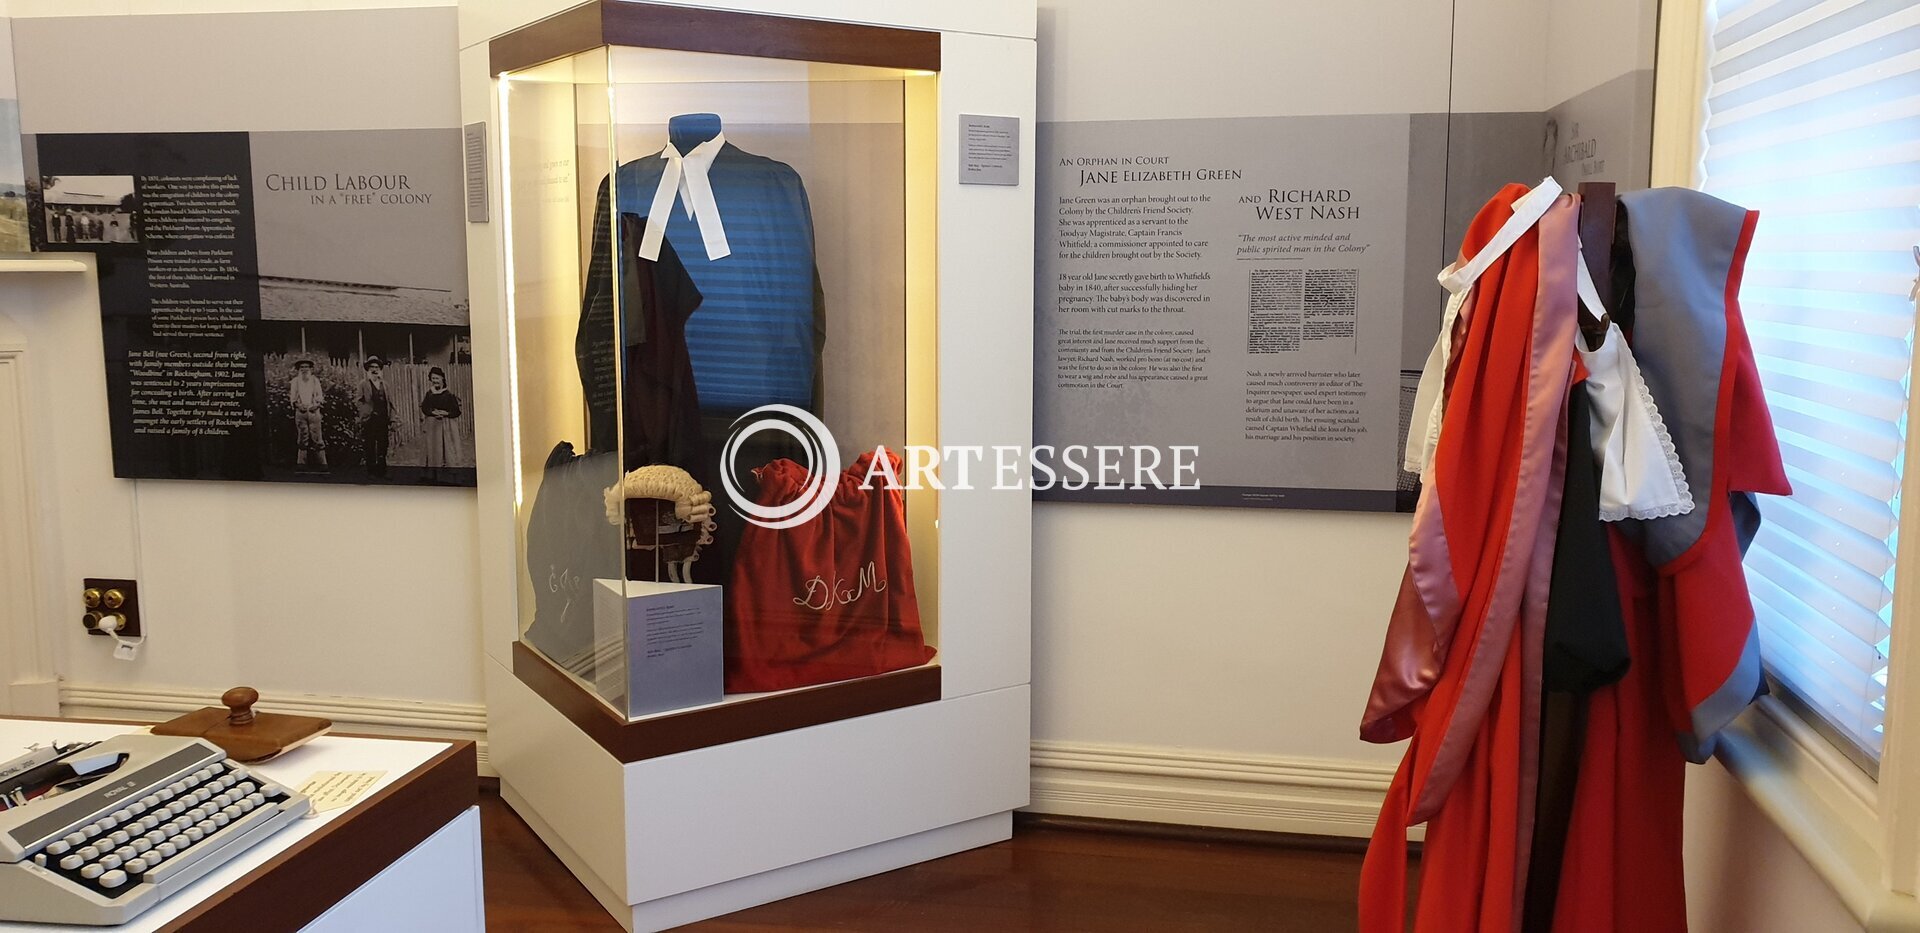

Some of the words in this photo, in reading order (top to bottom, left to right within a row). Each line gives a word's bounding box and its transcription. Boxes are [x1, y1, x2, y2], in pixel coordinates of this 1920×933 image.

[1059, 158, 1073, 166] AN
[1077, 157, 1117, 166] ORPHAN
[1136, 156, 1169, 165] COURT
[266, 174, 326, 191] CHILD
[336, 174, 410, 190] LABOUR
[1080, 170, 1118, 187] JANE
[1124, 170, 1191, 182] ELIZABETH
[1197, 169, 1242, 181] GREEN
[311, 195, 324, 204] IN
[329, 196, 336, 204] A
[380, 194, 432, 204] COLONY
[1121, 196, 1146, 205] orphan
[1148, 195, 1175, 204] brought
[1269, 189, 1351, 203] RICHARD
[1059, 208, 1084, 216] Colony
[1085, 207, 1094, 216] by
[1257, 206, 1303, 220] WEST
[1311, 206, 1360, 219] NASH
[1086, 218, 1126, 228] apprenticed
[1059, 229, 1087, 238] Toodyay
[1128, 229, 1155, 238] Captain
[1149, 240, 1184, 249] appointed
[1237, 246, 1260, 255] public
[1263, 245, 1291, 255] spirited
[1112, 251, 1139, 260] brought
[1153, 251, 1161, 260] by
[1109, 273, 1133, 281] secretly
[1059, 285, 1074, 293] baby
[1121, 284, 1160, 292] successfully
